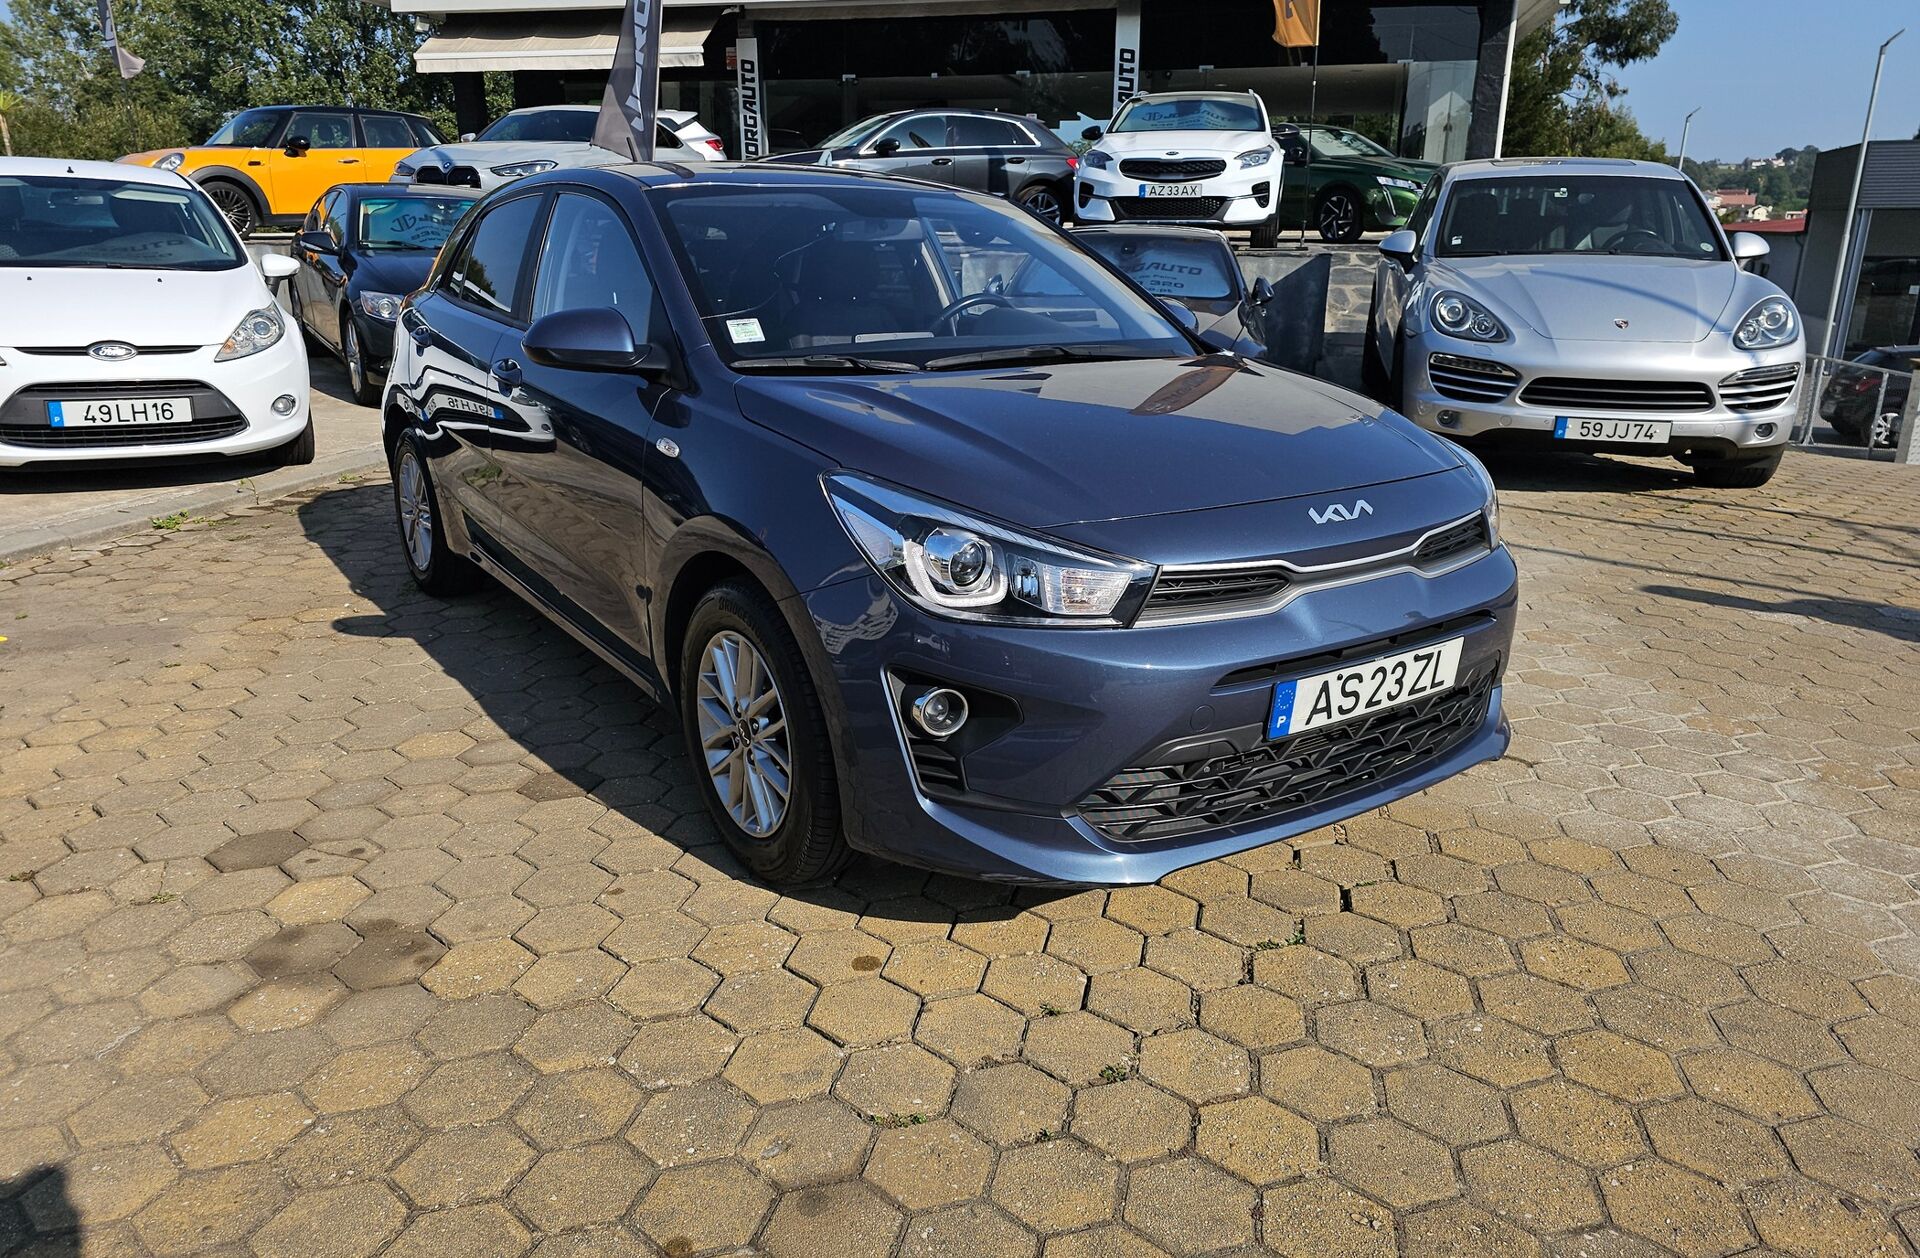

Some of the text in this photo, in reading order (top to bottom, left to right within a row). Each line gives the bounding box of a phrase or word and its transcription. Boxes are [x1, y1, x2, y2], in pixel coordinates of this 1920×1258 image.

[1149, 185, 1198, 196] AZ33AX
[84, 402, 173, 424] 49LH16
[1579, 421, 1654, 440] 59JJ74
[1307, 499, 1374, 524] KIA
[1276, 650, 1445, 728] P AS23ZL
